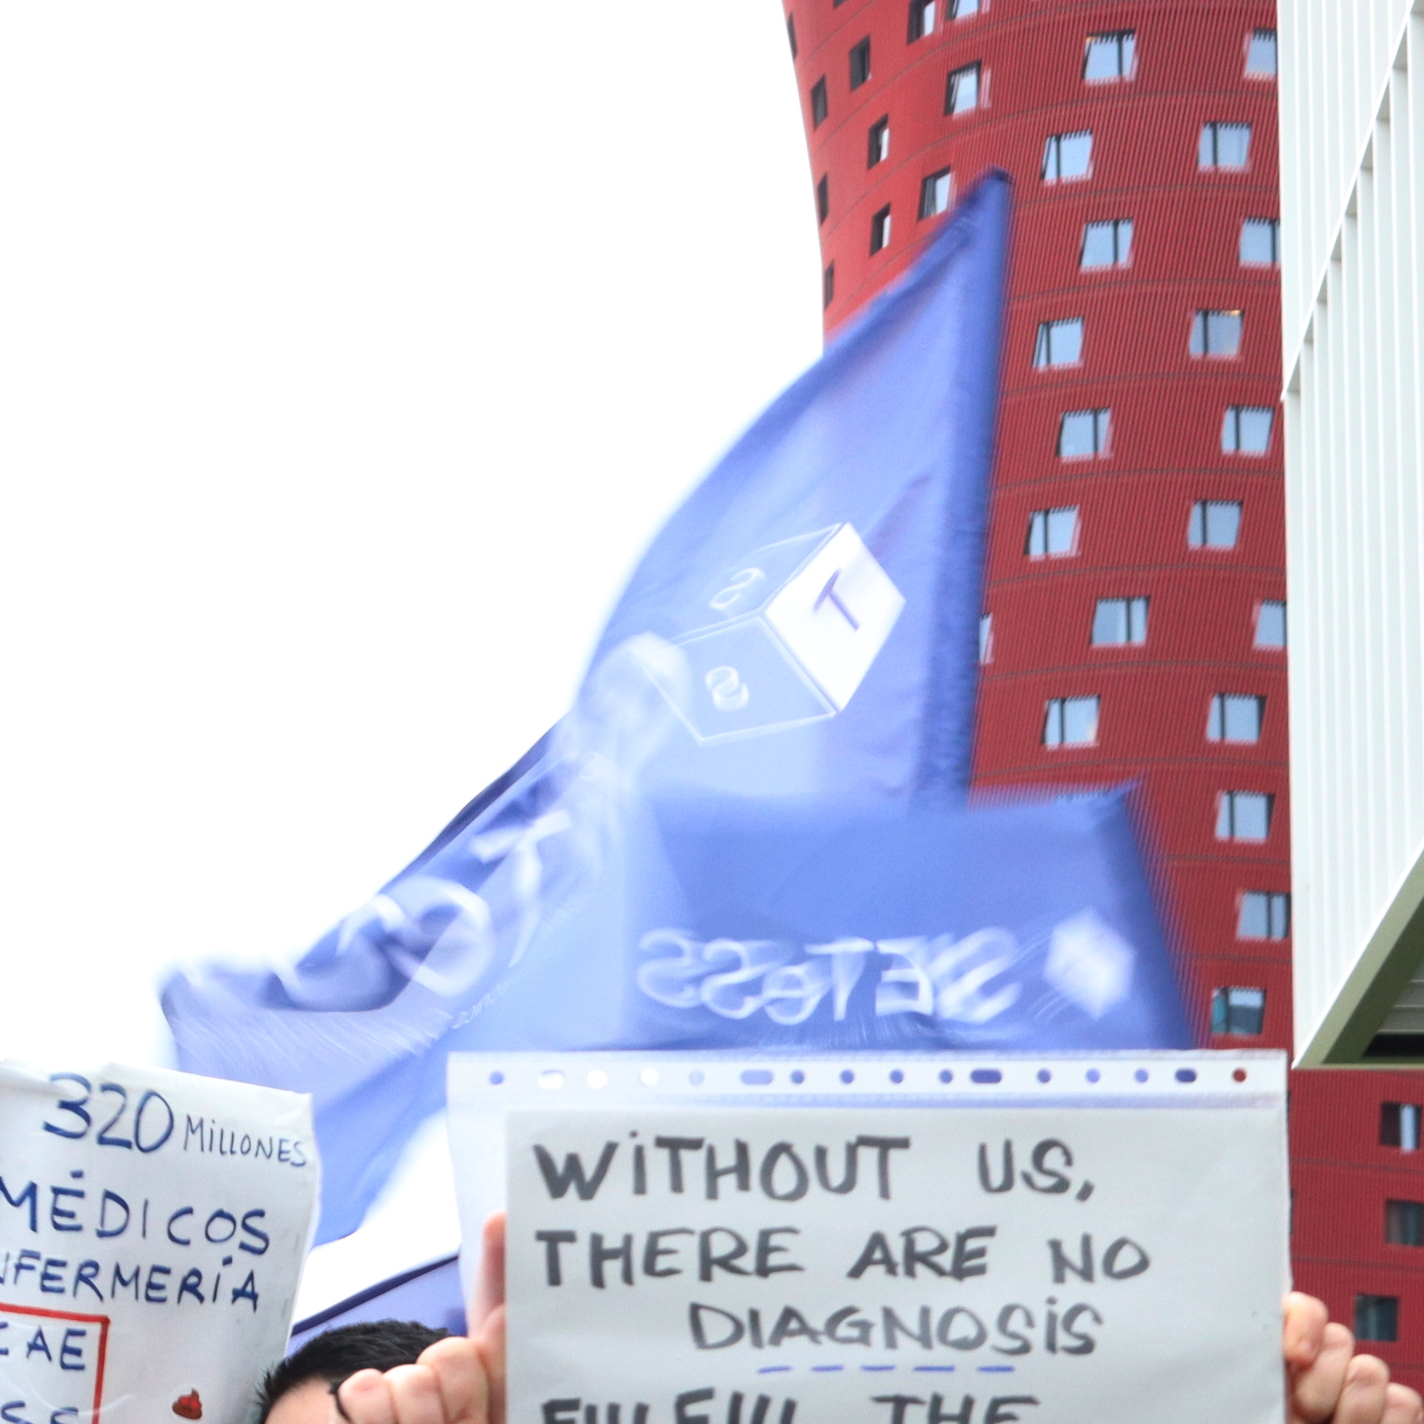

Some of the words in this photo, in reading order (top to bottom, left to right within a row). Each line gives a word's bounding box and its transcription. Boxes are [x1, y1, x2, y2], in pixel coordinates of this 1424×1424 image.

[43, 1073, 175, 1154] 320
[977, 1138, 1094, 1201] US,
[535, 1228, 804, 1289] THERE
[848, 1225, 997, 1279] ARE
[1050, 1234, 1150, 1284] NO
